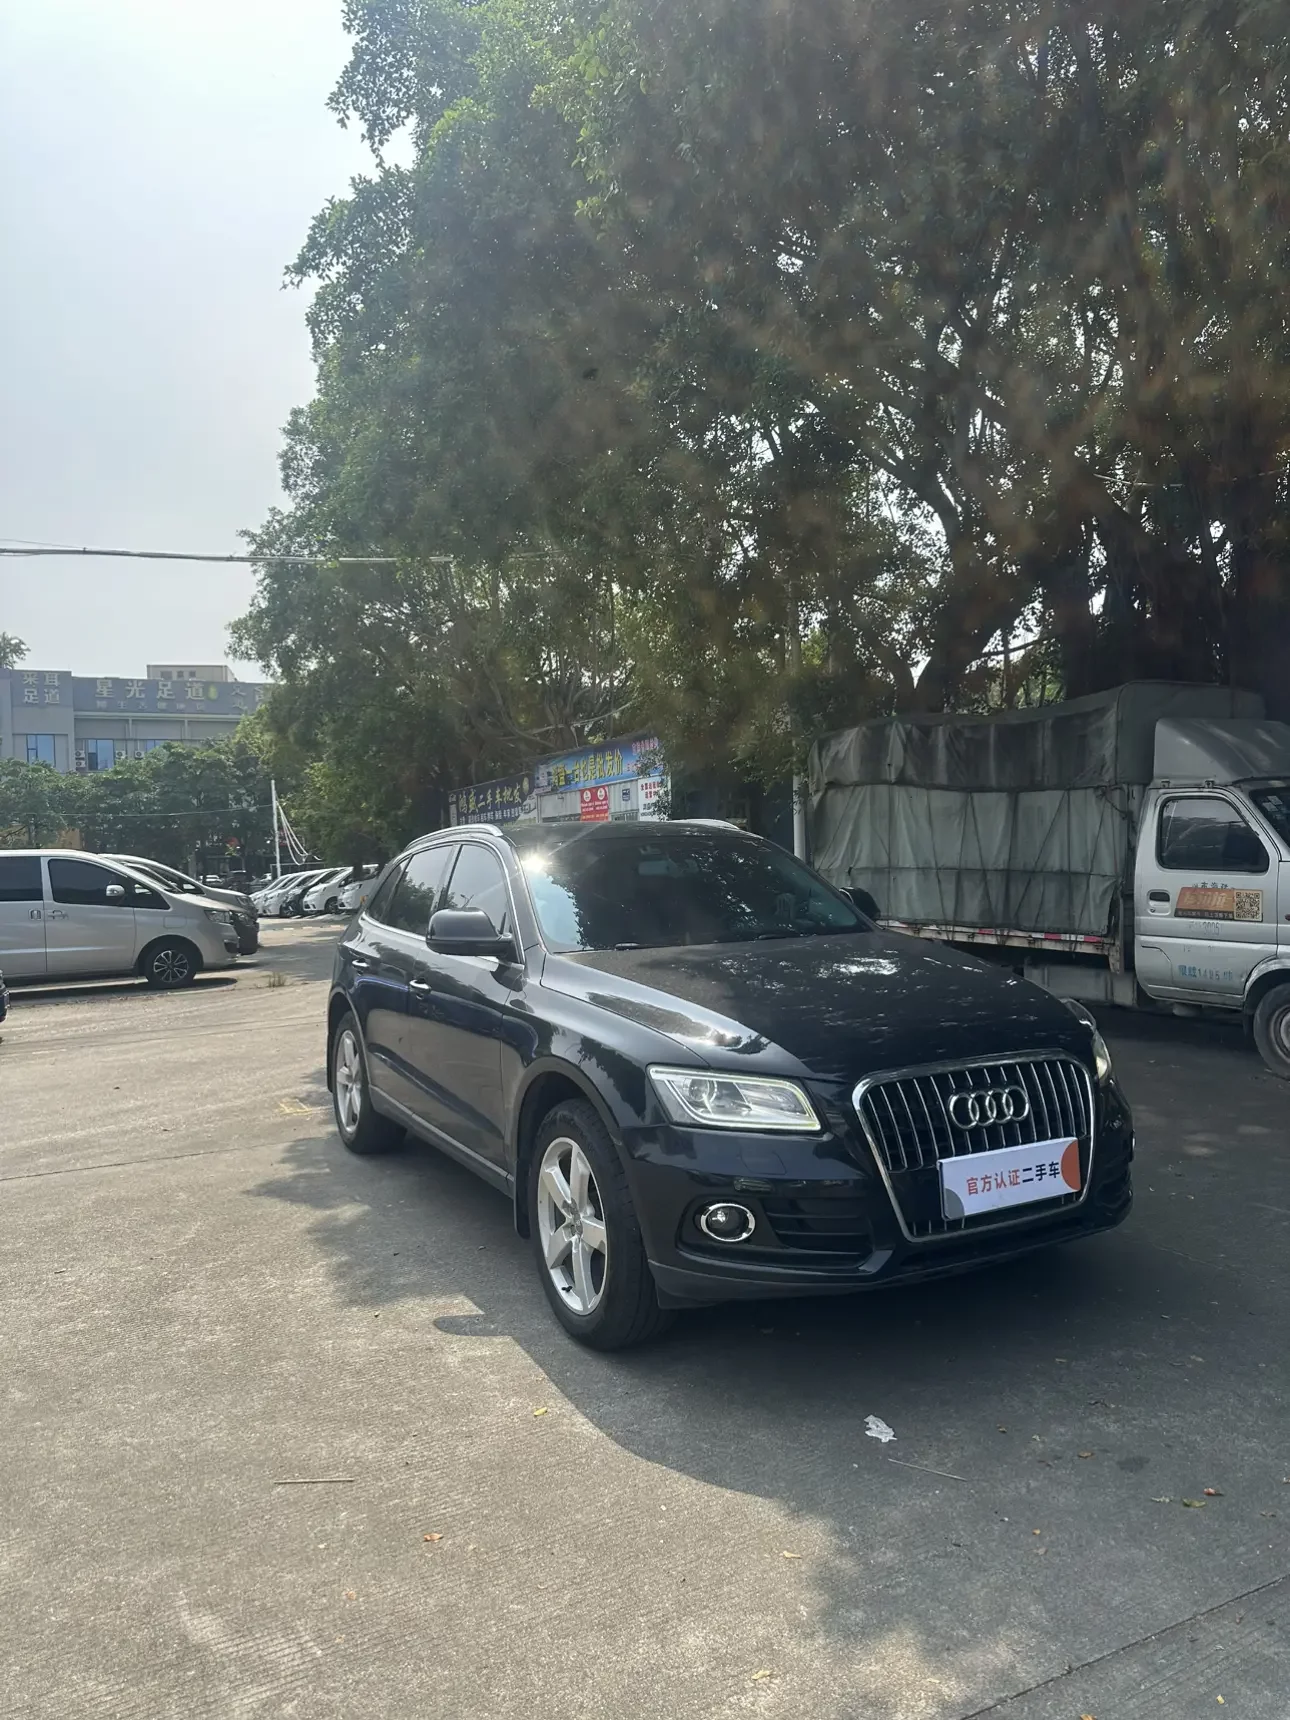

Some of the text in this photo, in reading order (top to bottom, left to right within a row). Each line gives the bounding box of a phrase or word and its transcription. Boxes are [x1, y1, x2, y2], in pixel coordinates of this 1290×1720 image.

[22, 688, 60, 704] 足道
[95, 679, 206, 700] 星光足道
[966, 1161, 1060, 1196] 官方认证二手车
